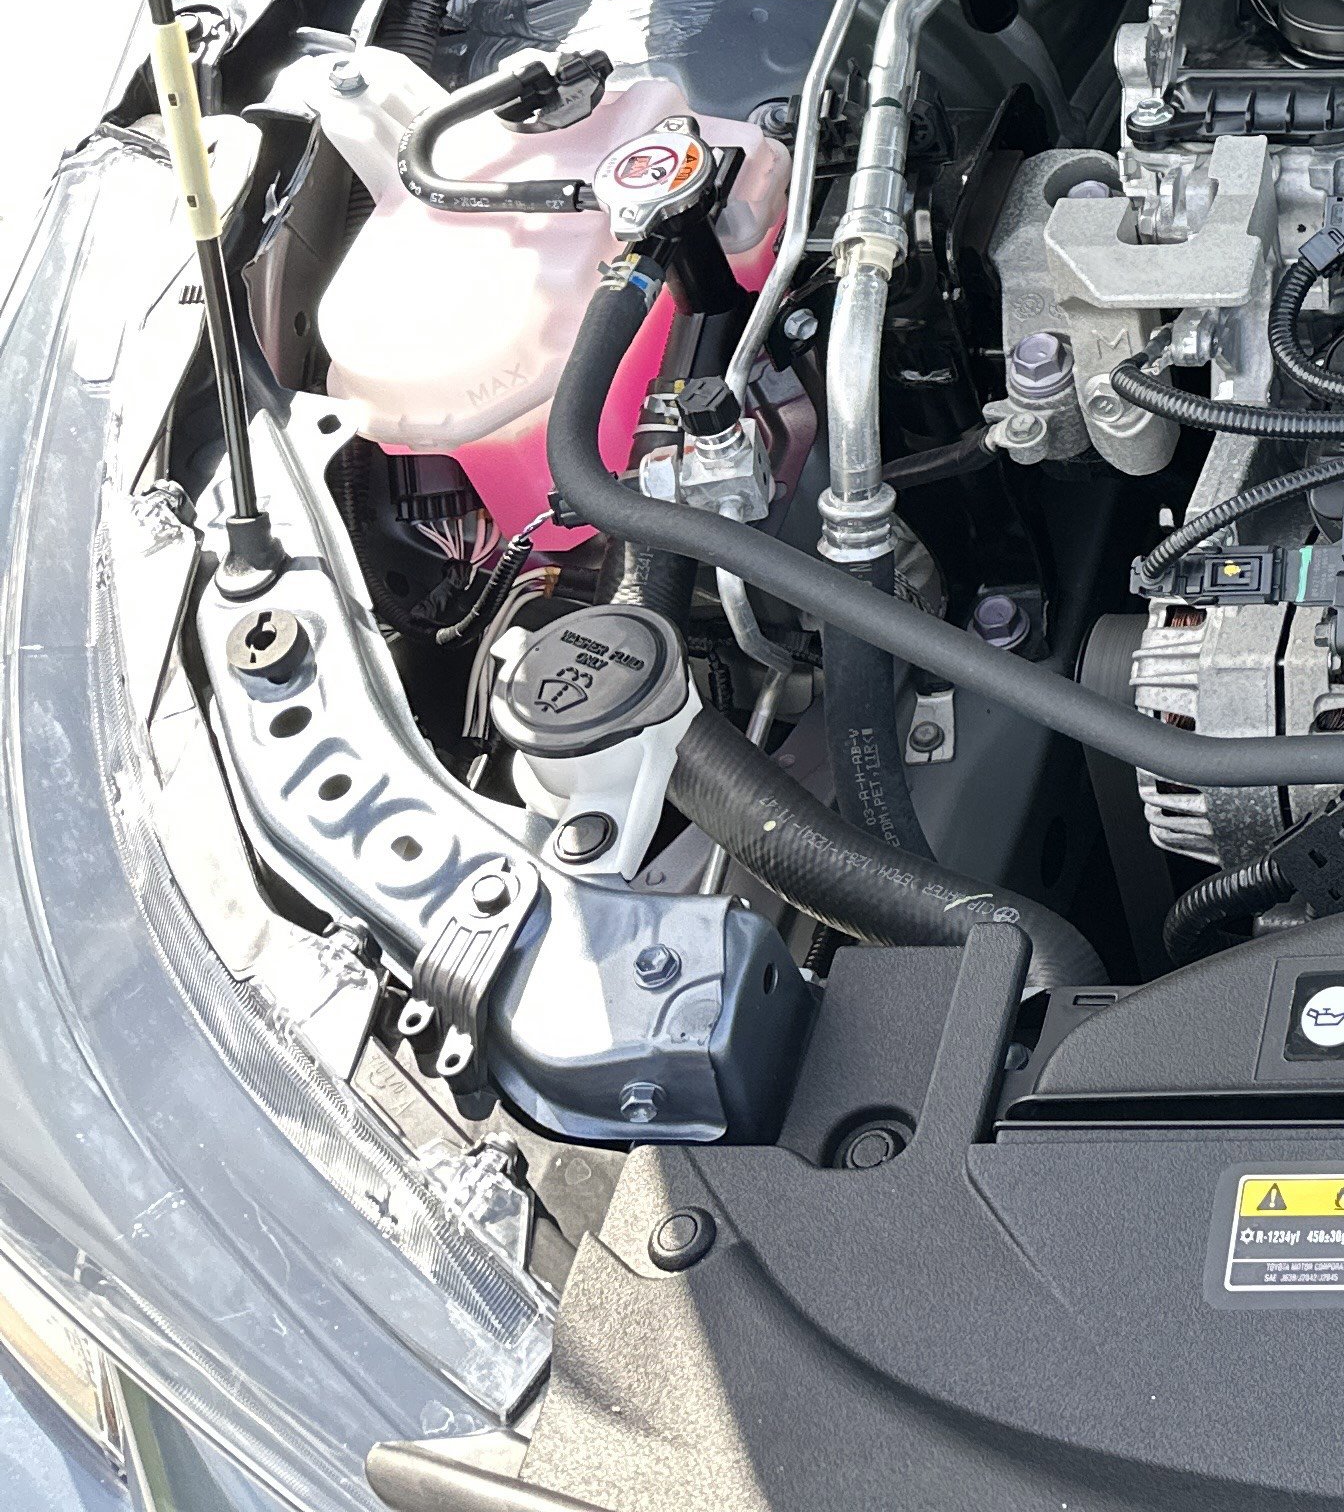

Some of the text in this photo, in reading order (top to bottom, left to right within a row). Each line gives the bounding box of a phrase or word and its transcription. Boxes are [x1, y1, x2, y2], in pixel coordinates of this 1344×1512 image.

[466, 363, 527, 406] MAX
[575, 652, 609, 671] ONLY
[1256, 1230, 1300, 1245] R-1234yf
